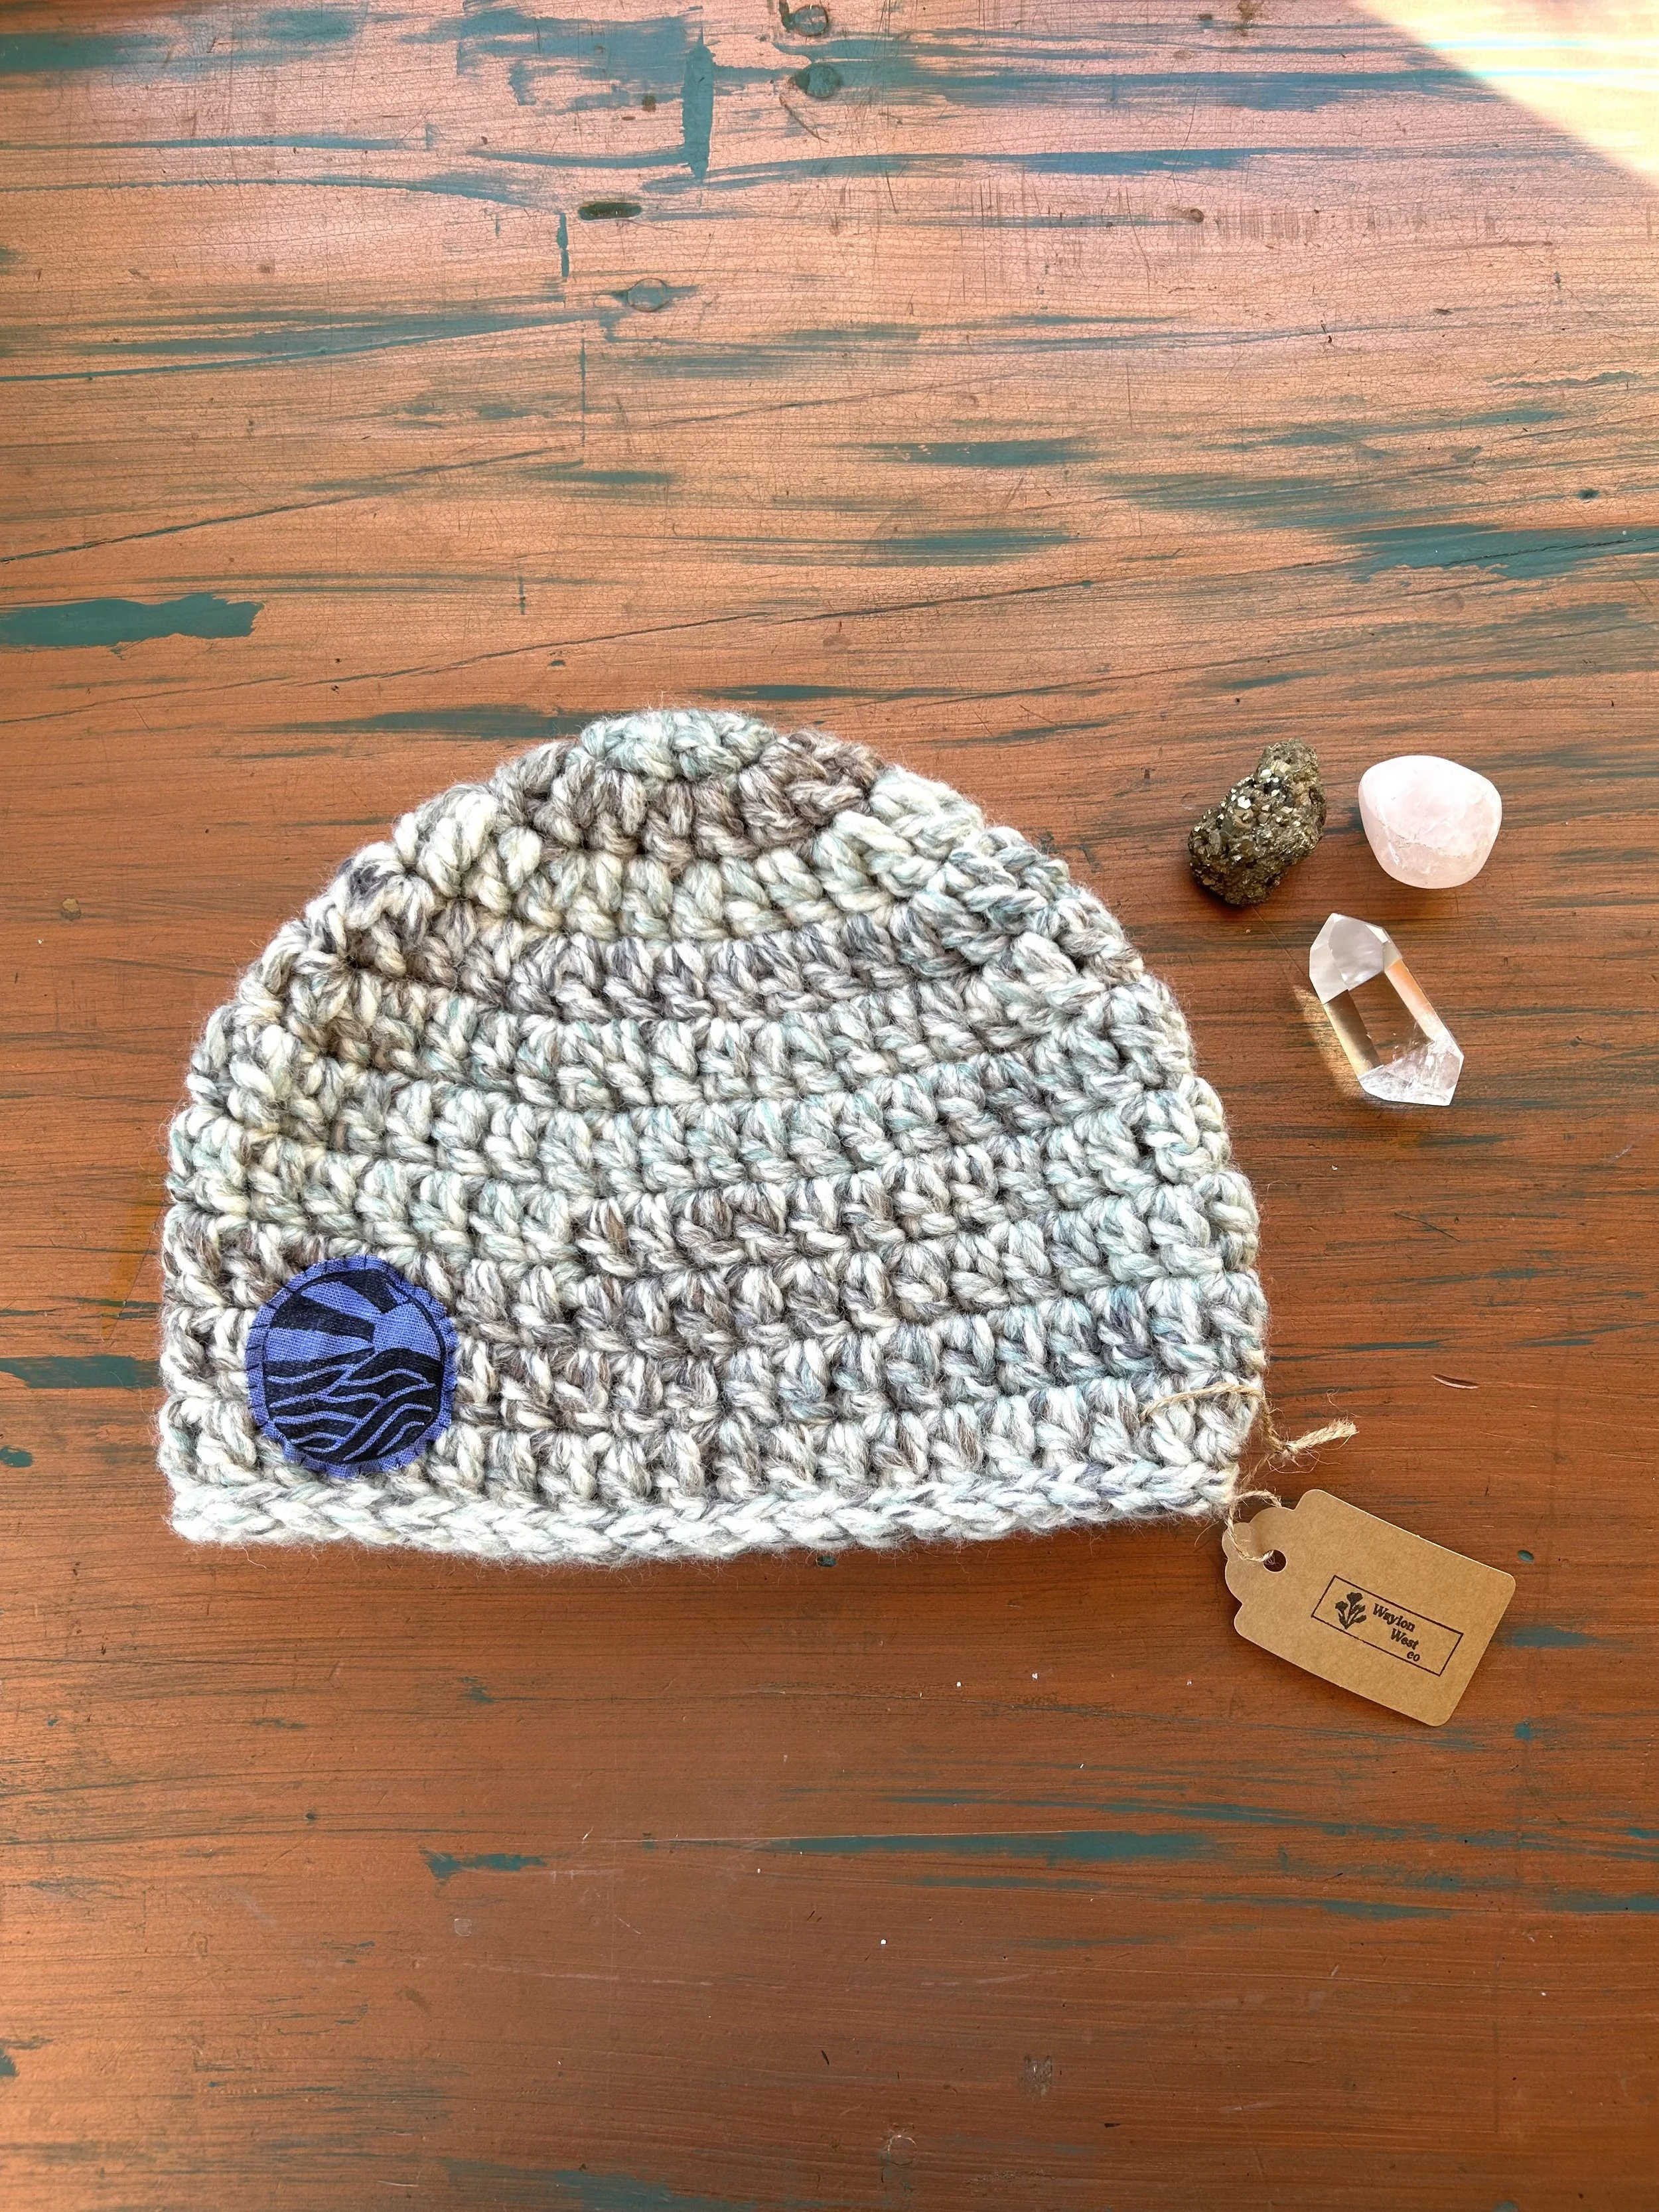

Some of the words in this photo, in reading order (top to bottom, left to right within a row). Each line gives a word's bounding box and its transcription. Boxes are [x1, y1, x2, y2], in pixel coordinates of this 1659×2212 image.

[1372, 1603, 1415, 1632] Waylon
[1390, 1628, 1419, 1650] West
[1406, 1651, 1420, 1662] co
